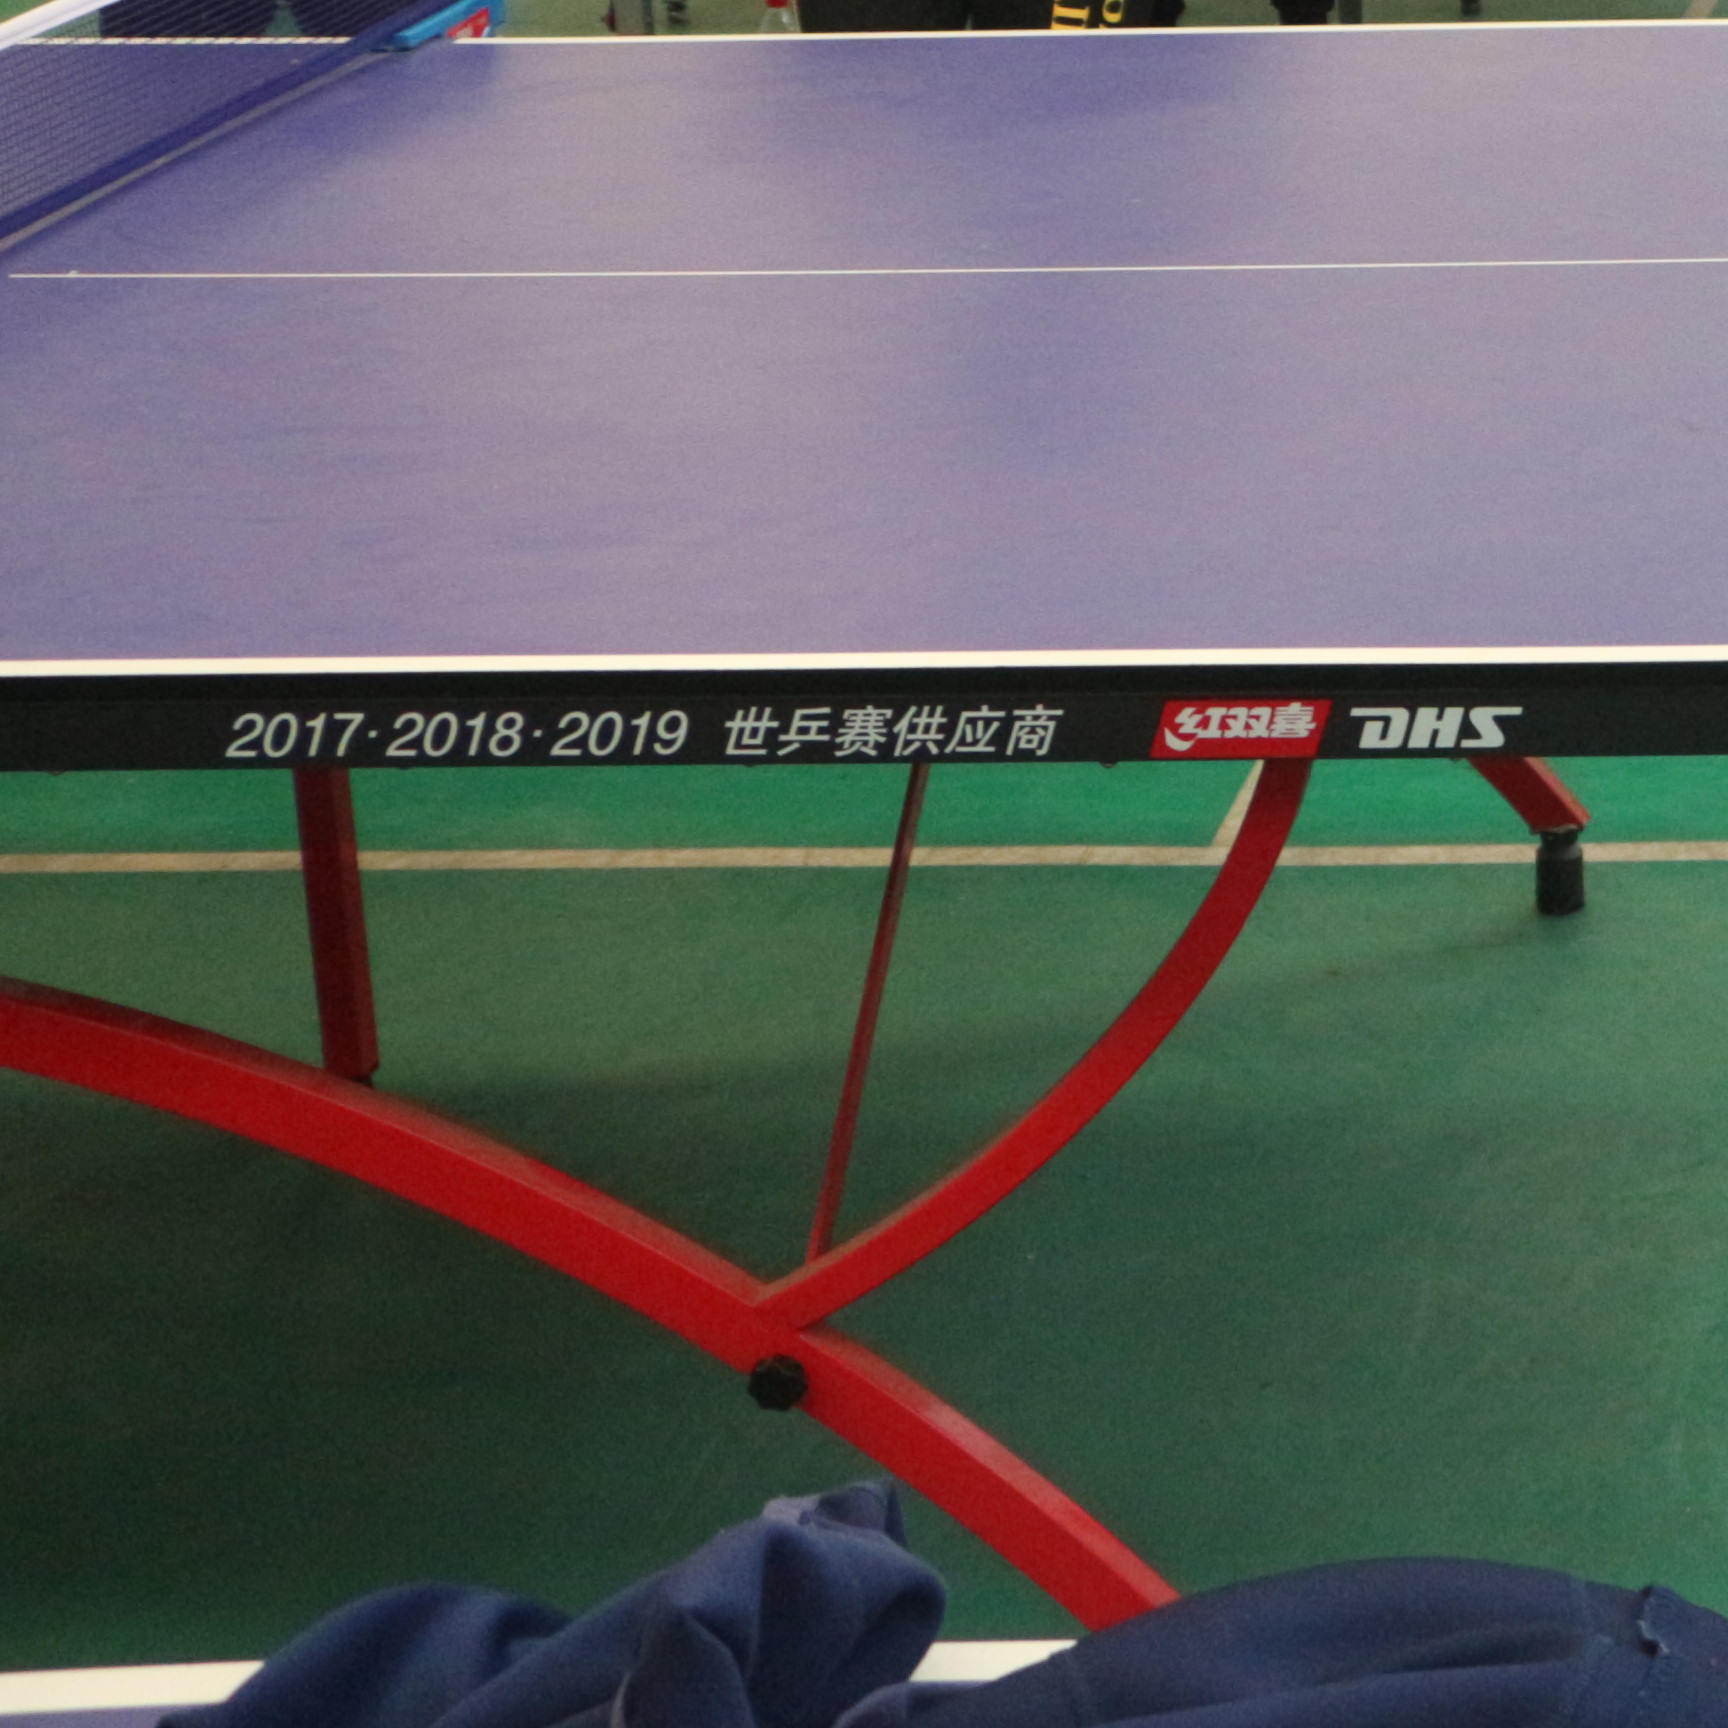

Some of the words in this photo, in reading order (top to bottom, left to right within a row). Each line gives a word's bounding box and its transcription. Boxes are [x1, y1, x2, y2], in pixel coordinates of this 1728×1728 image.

[723, 704, 1065, 757] 世乒赛供应商
[1163, 701, 1318, 753] 红双喜
[1350, 706, 1524, 750] DHS
